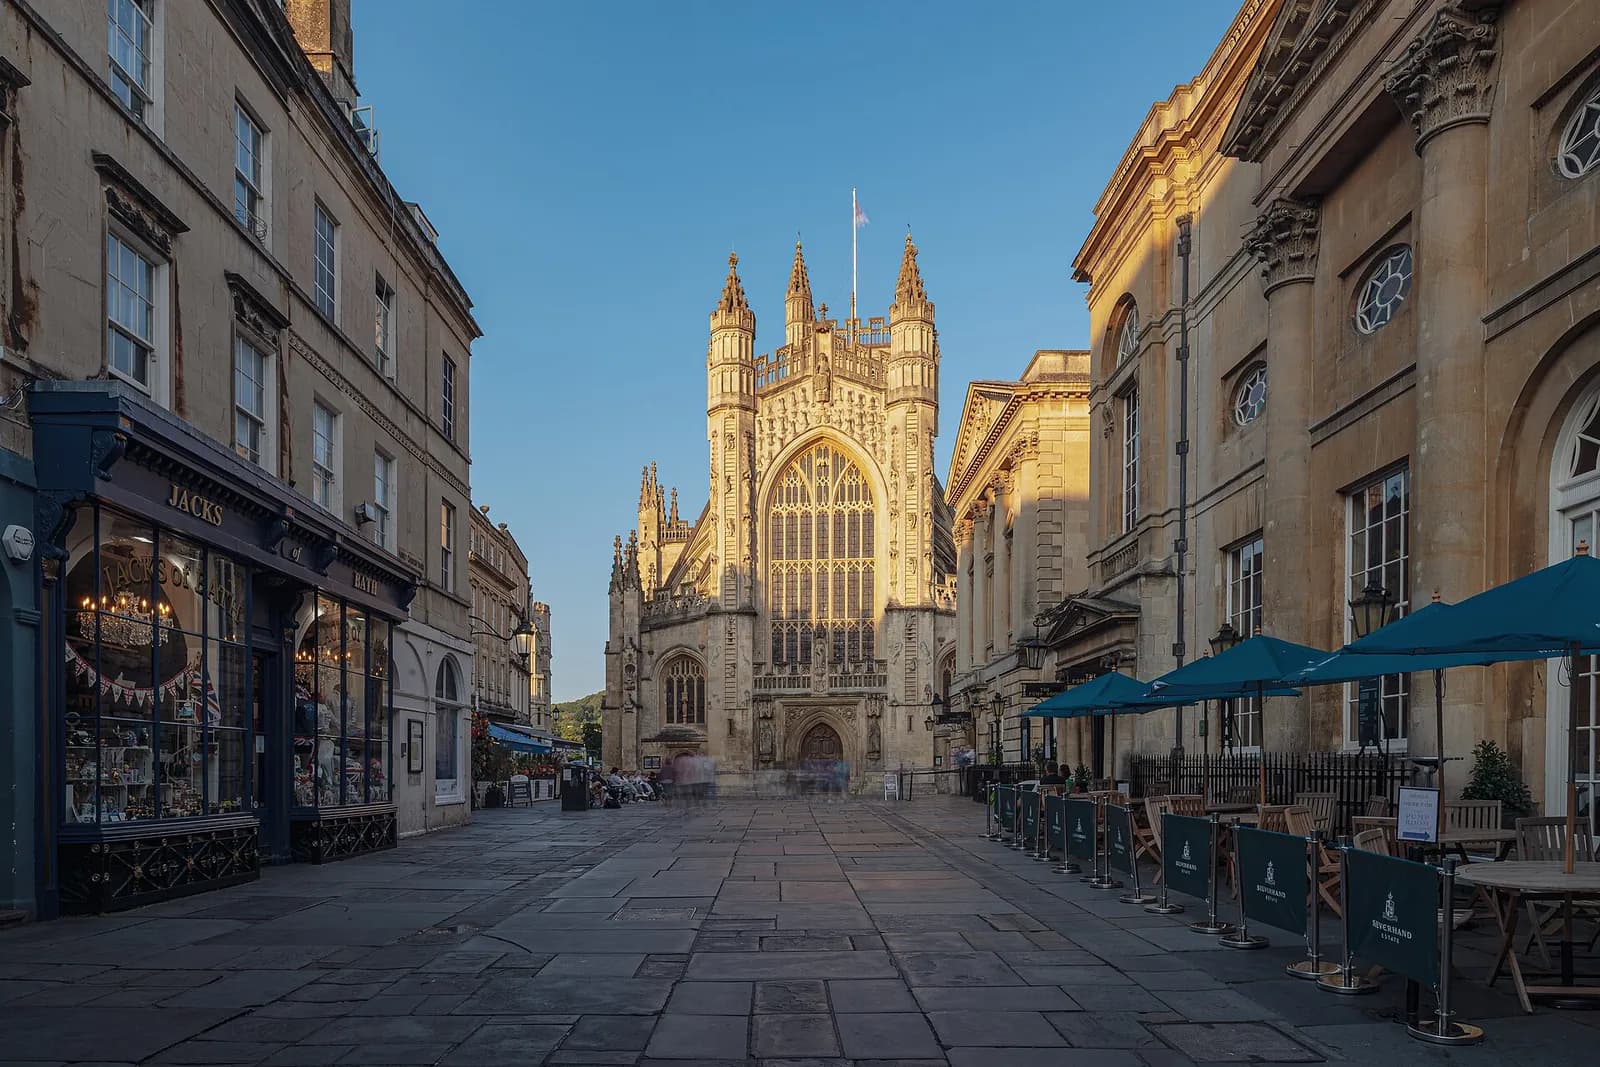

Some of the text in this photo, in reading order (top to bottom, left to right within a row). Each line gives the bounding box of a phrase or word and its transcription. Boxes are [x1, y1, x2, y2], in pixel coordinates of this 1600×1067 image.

[168, 485, 379, 596] JACKS of BATH
[103, 556, 168, 597] JACKS
[1372, 919, 1413, 940] SILVERHAND
[1381, 932, 1400, 945] ESTATE
